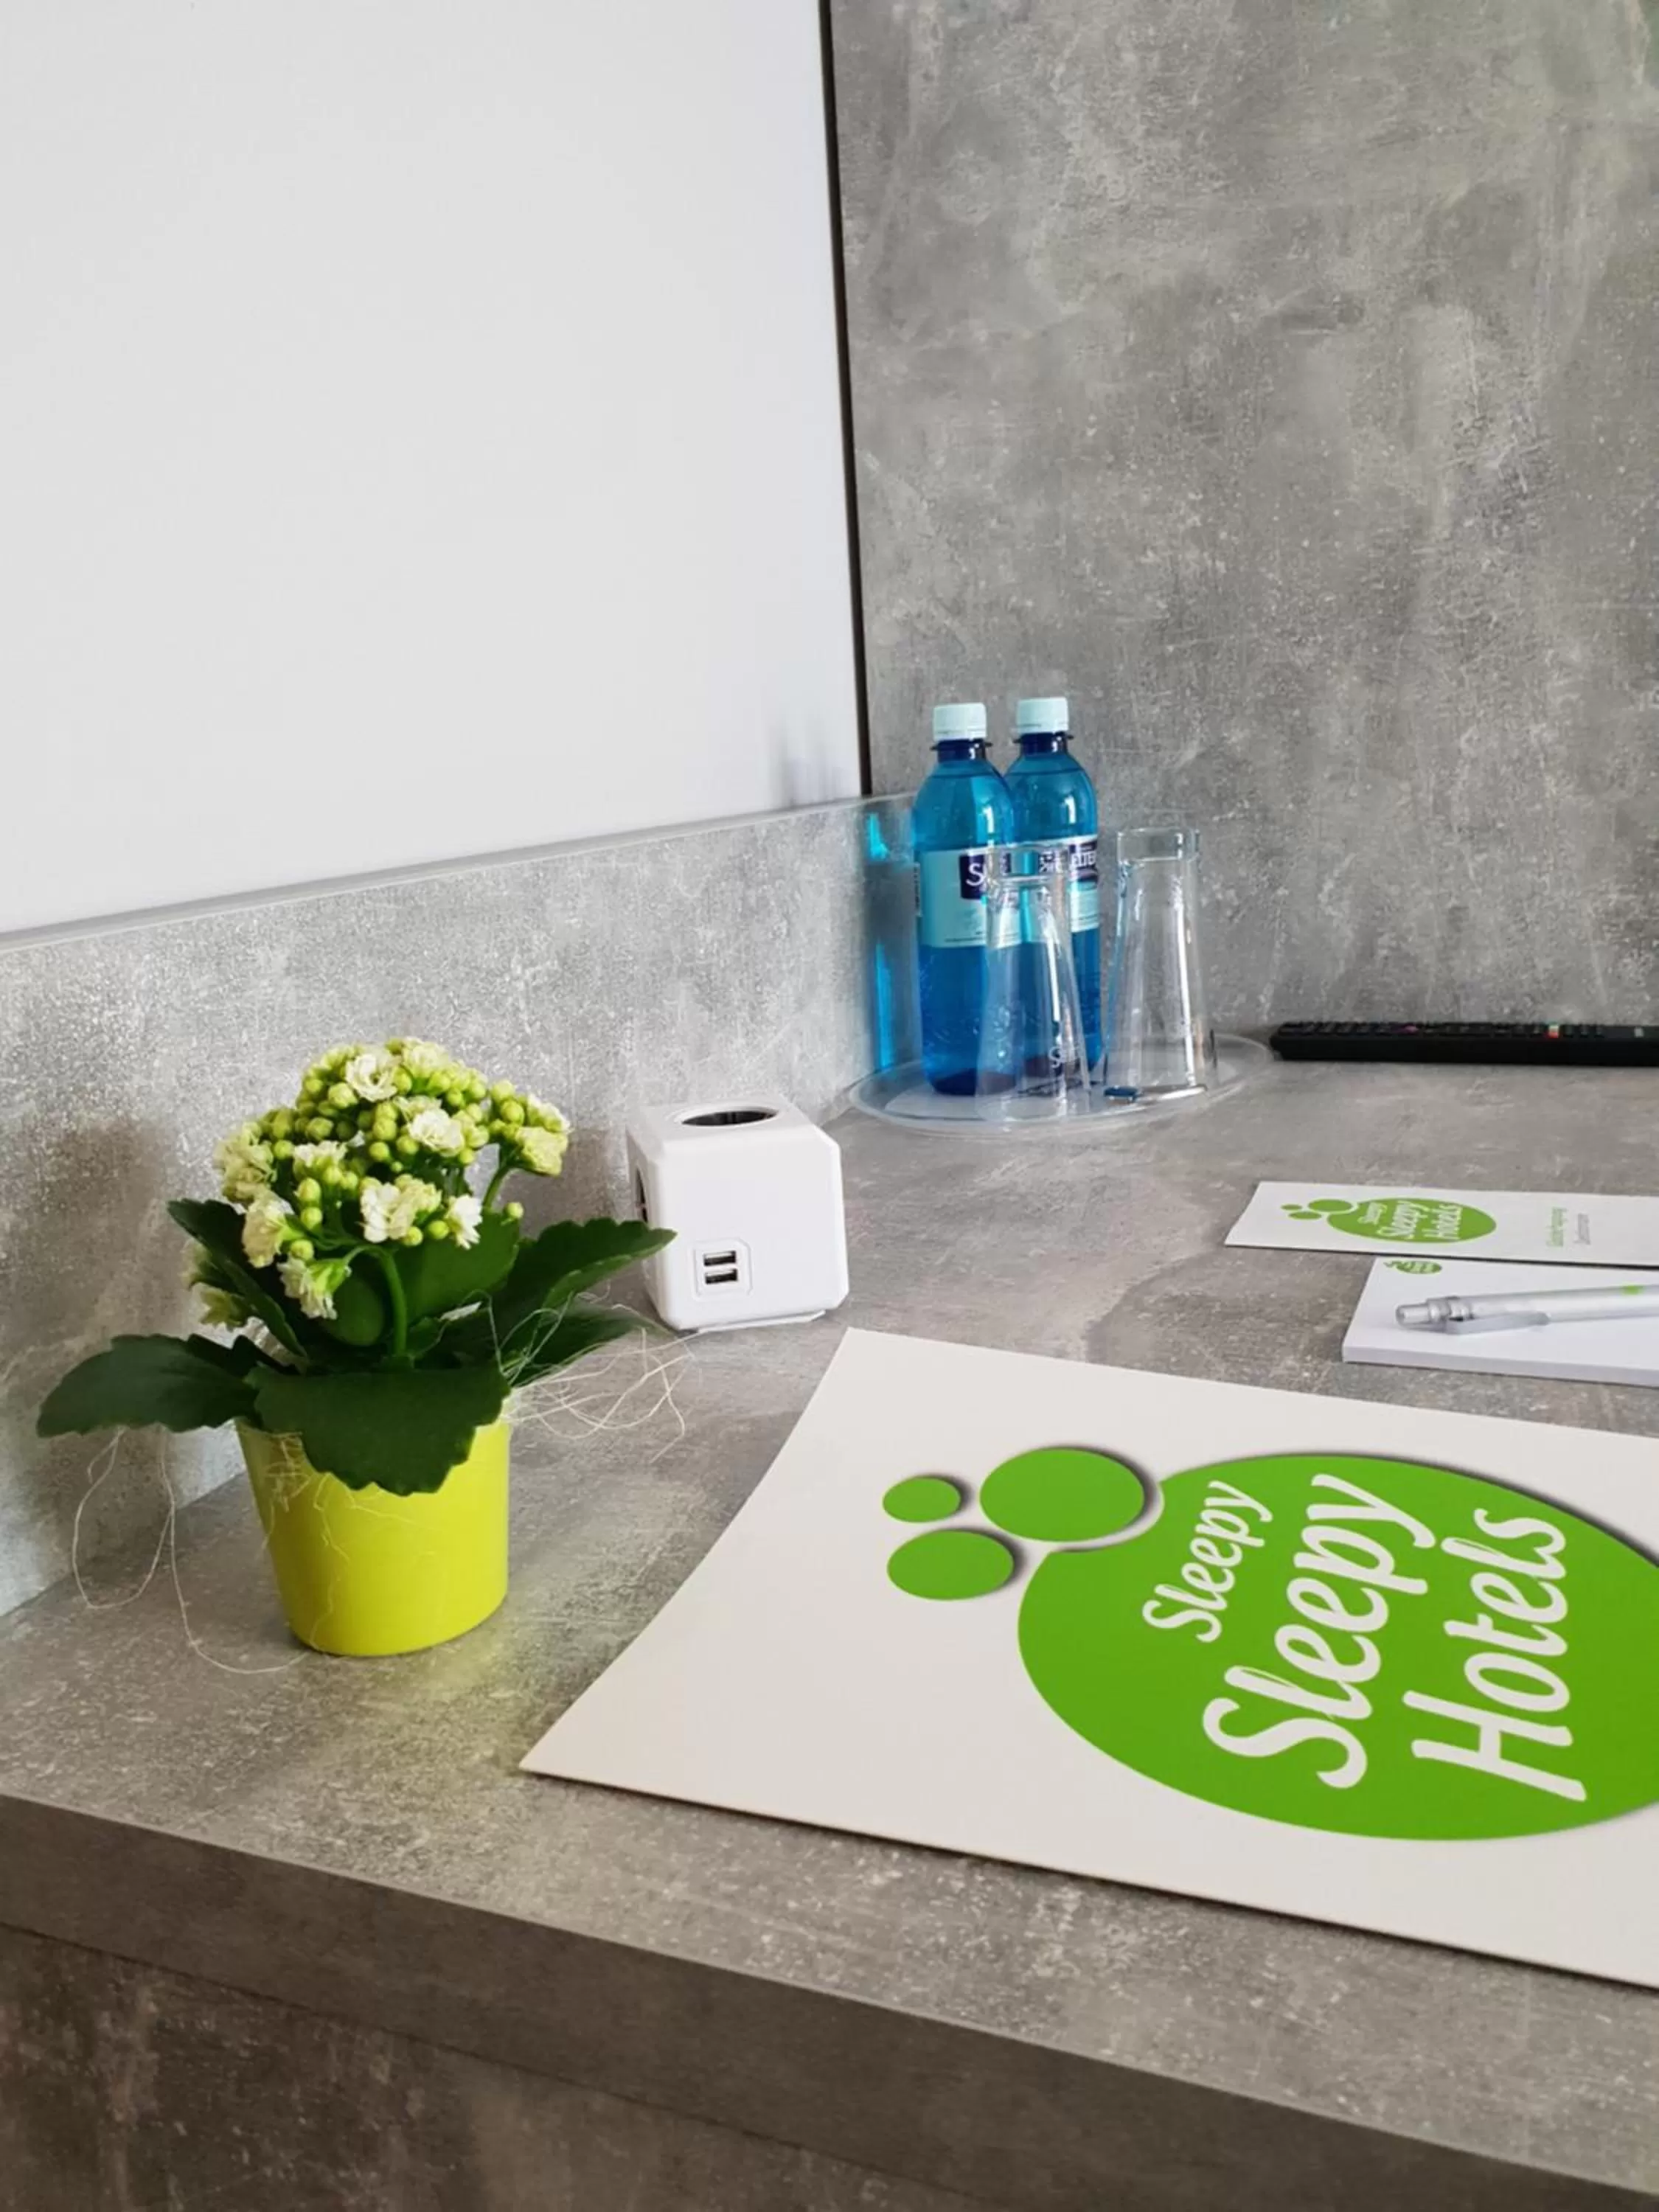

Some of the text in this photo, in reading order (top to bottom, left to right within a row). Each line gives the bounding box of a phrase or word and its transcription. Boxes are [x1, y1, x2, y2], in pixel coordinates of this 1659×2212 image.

[1141, 1480, 1273, 1643] Sleepy
[1203, 1474, 1436, 1789] Sleepy
[1402, 1508, 1587, 1801] Hotels
